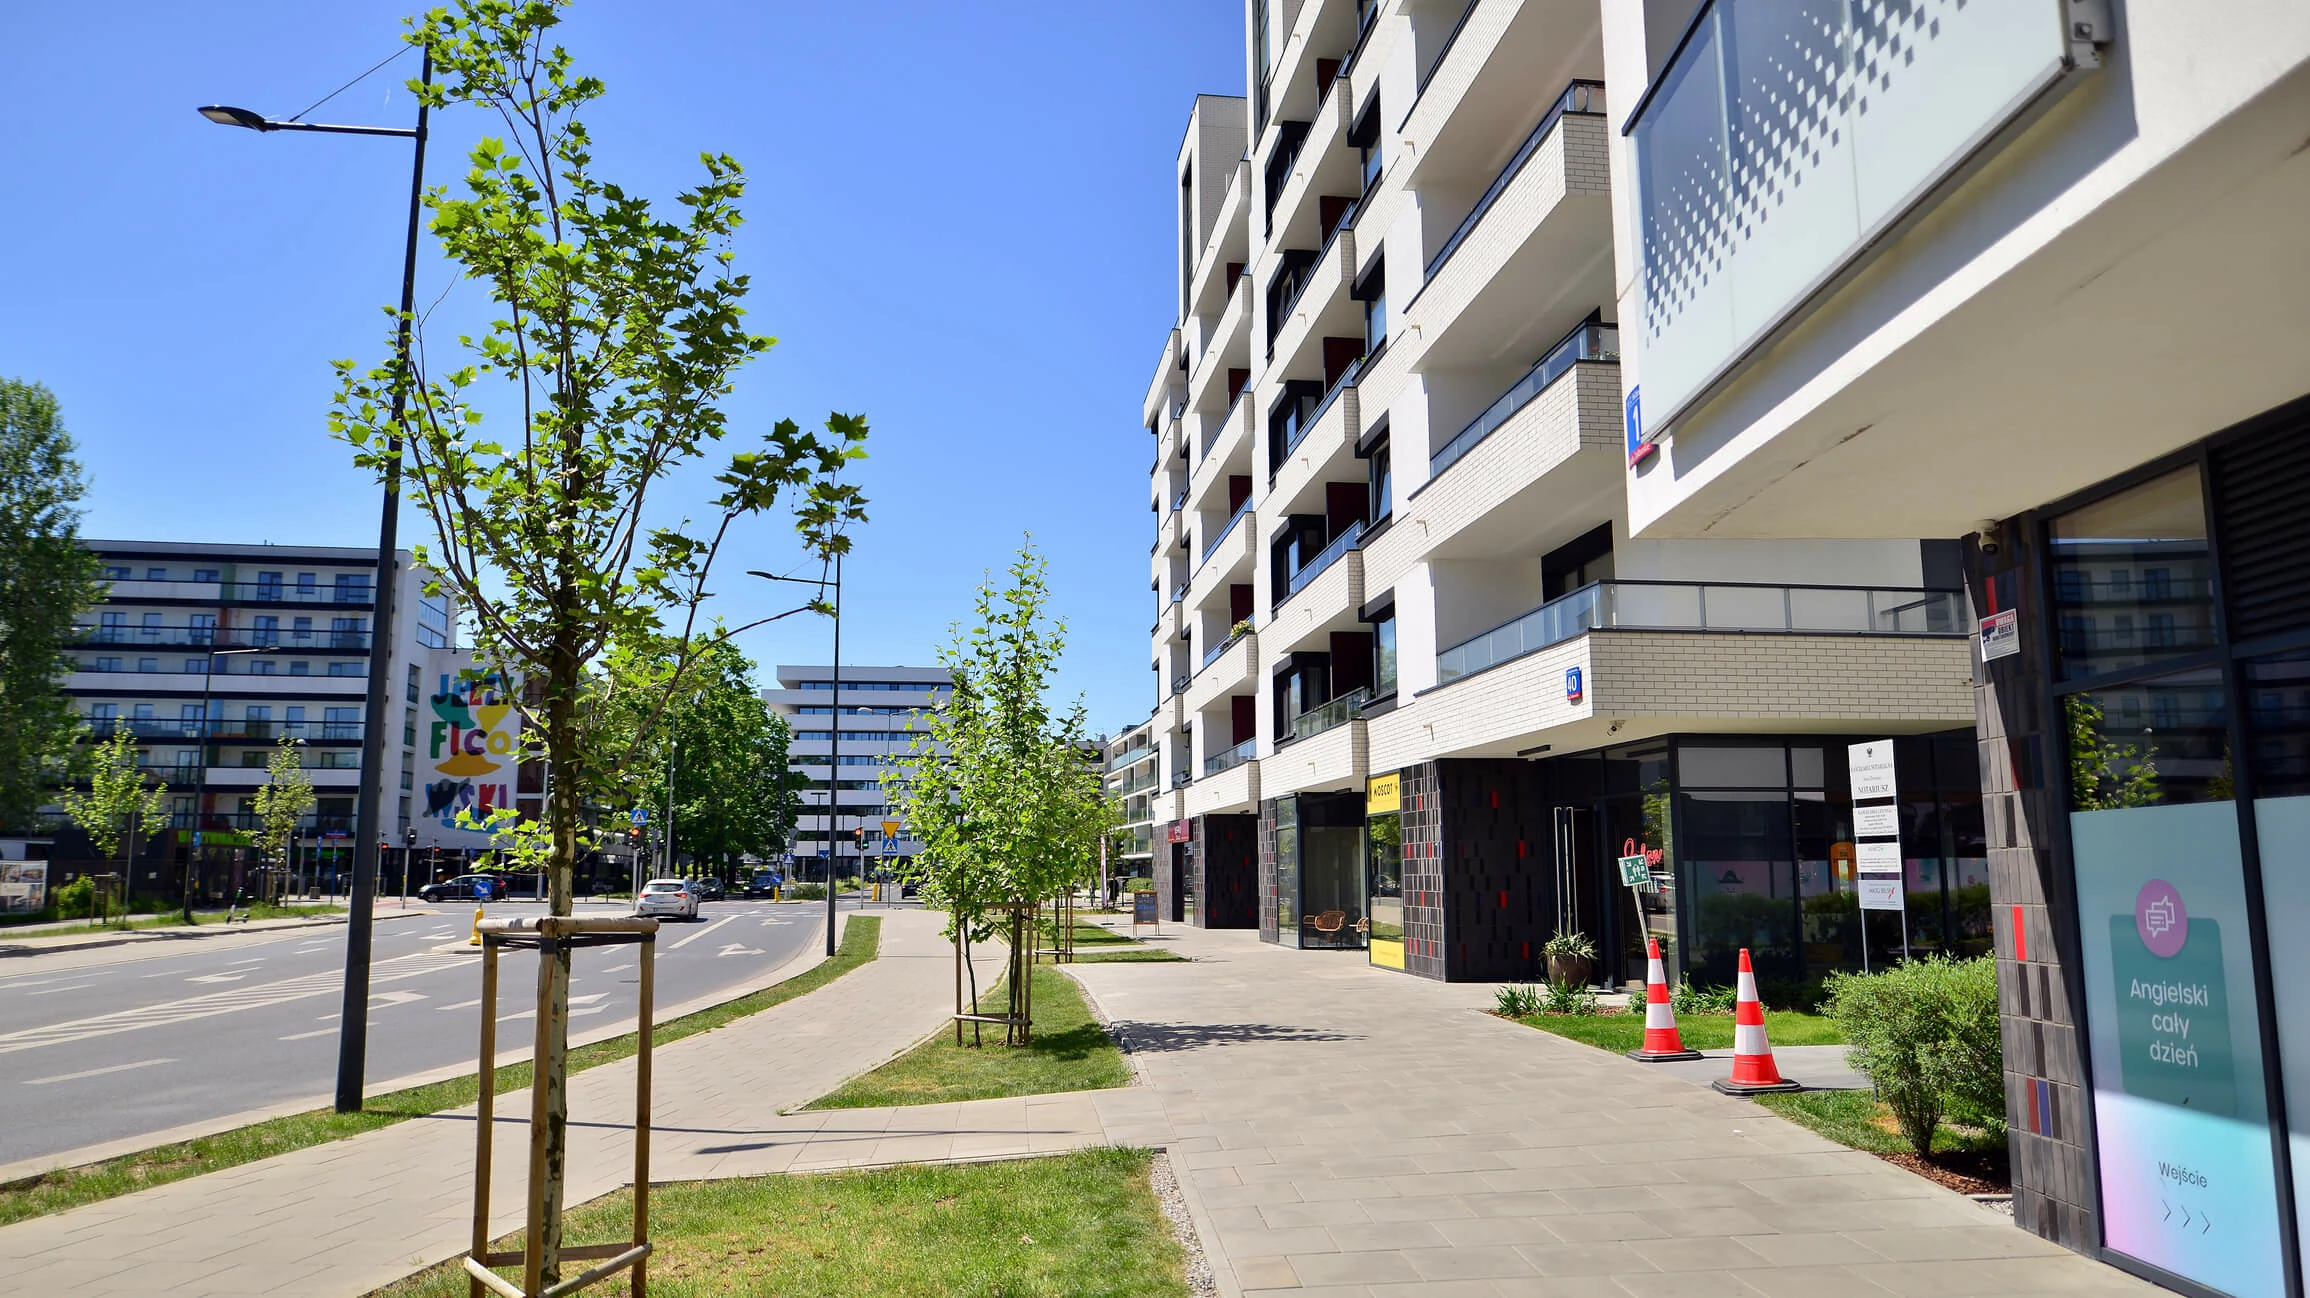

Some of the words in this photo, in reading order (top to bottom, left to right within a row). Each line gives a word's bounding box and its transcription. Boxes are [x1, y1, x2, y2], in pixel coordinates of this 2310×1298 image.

[1567, 675, 1577, 692] 40
[430, 721, 511, 759] FICO
[2130, 979, 2208, 1007] Angielski
[2152, 1013, 2189, 1040] cały
[2150, 1040, 2198, 1068] dzień
[2158, 1161, 2208, 1188] Wejście
